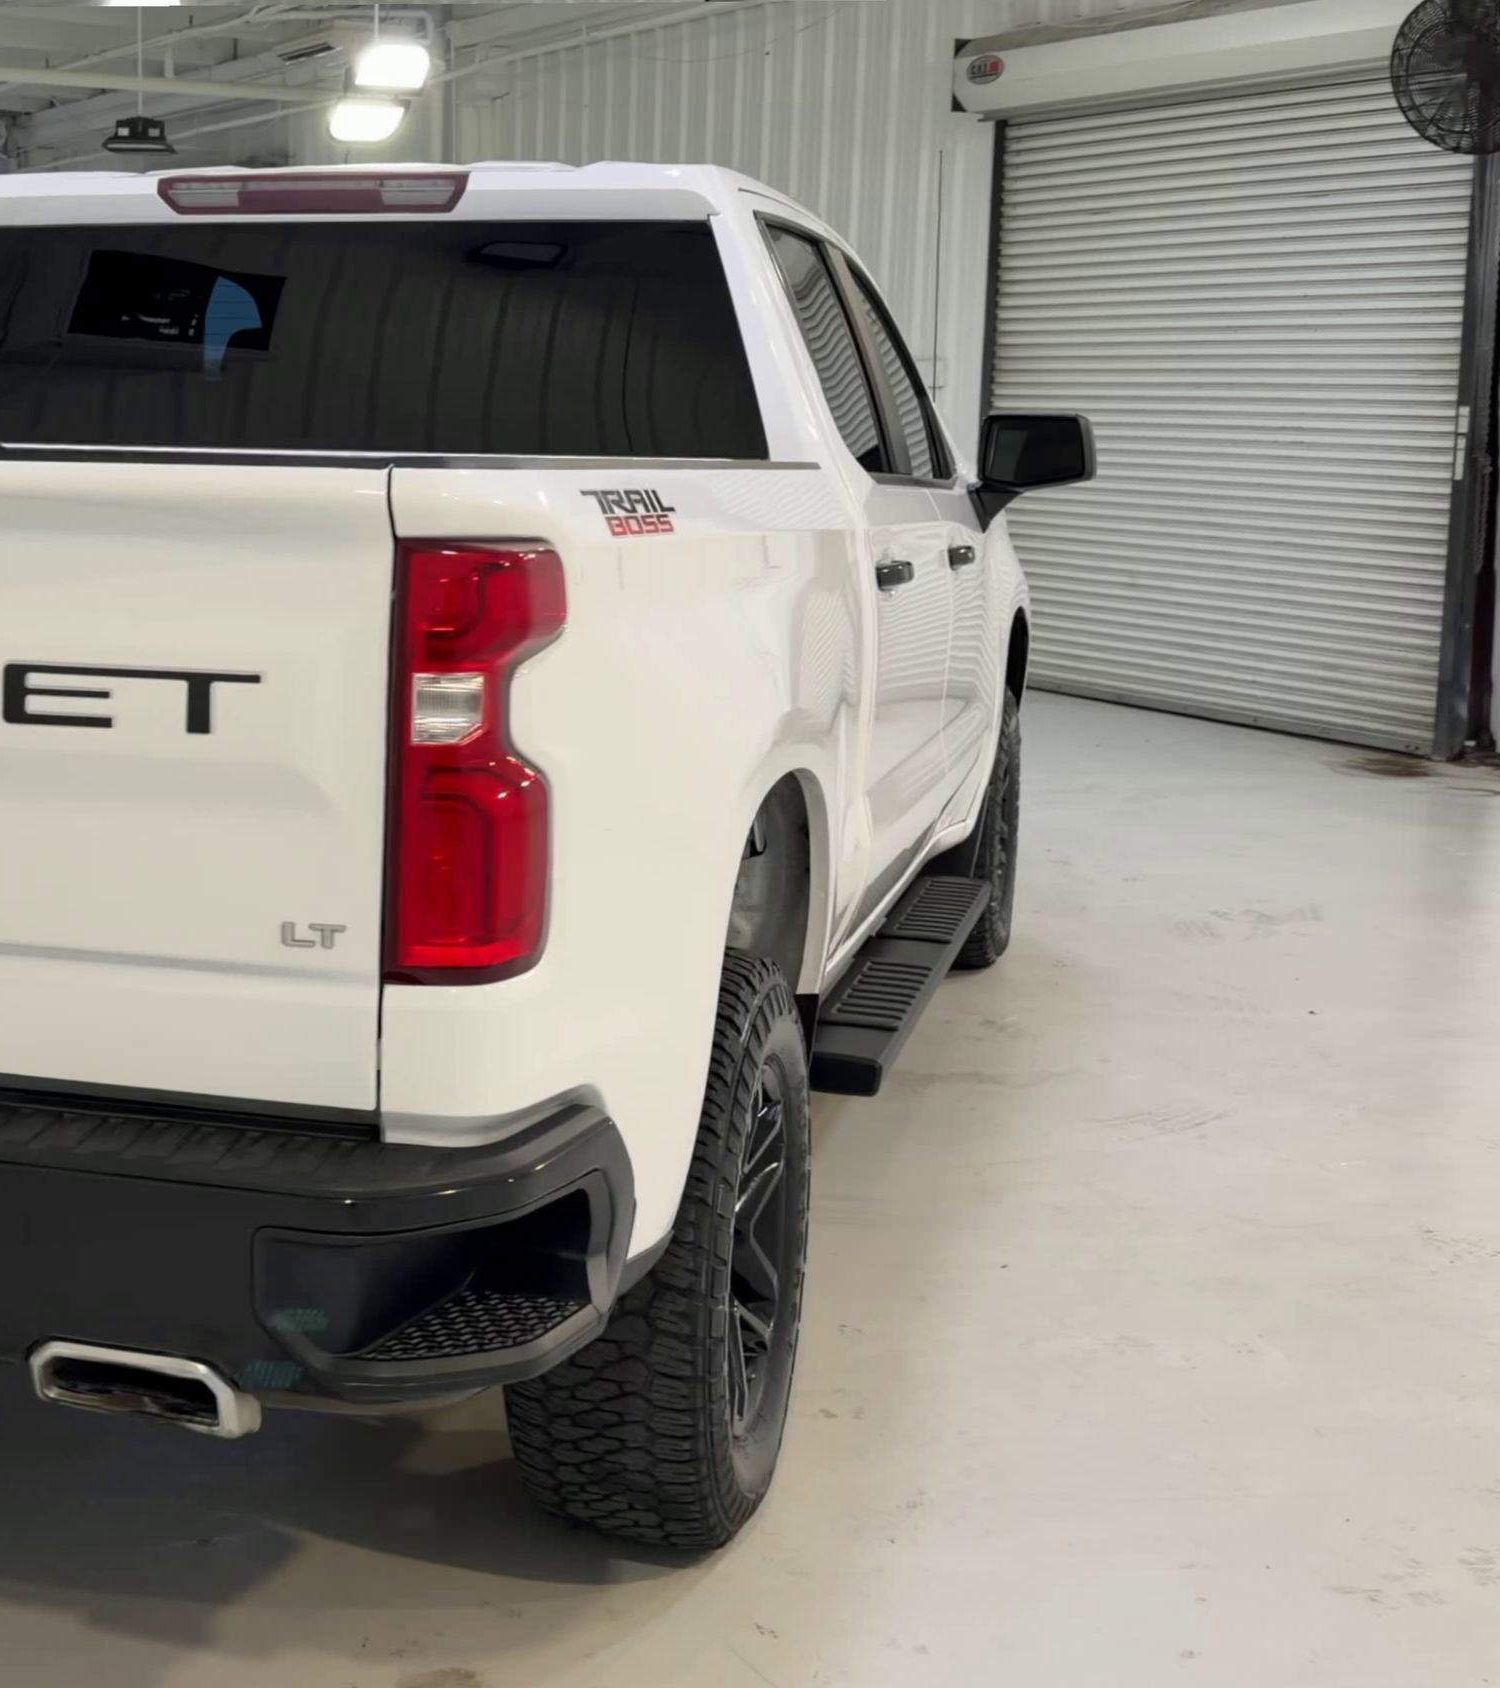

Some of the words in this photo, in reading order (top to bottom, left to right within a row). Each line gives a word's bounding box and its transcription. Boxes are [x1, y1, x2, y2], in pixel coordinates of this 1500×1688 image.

[580, 489, 676, 514] TRAIL
[604, 513, 674, 537] BOSS
[281, 921, 347, 949] LT
